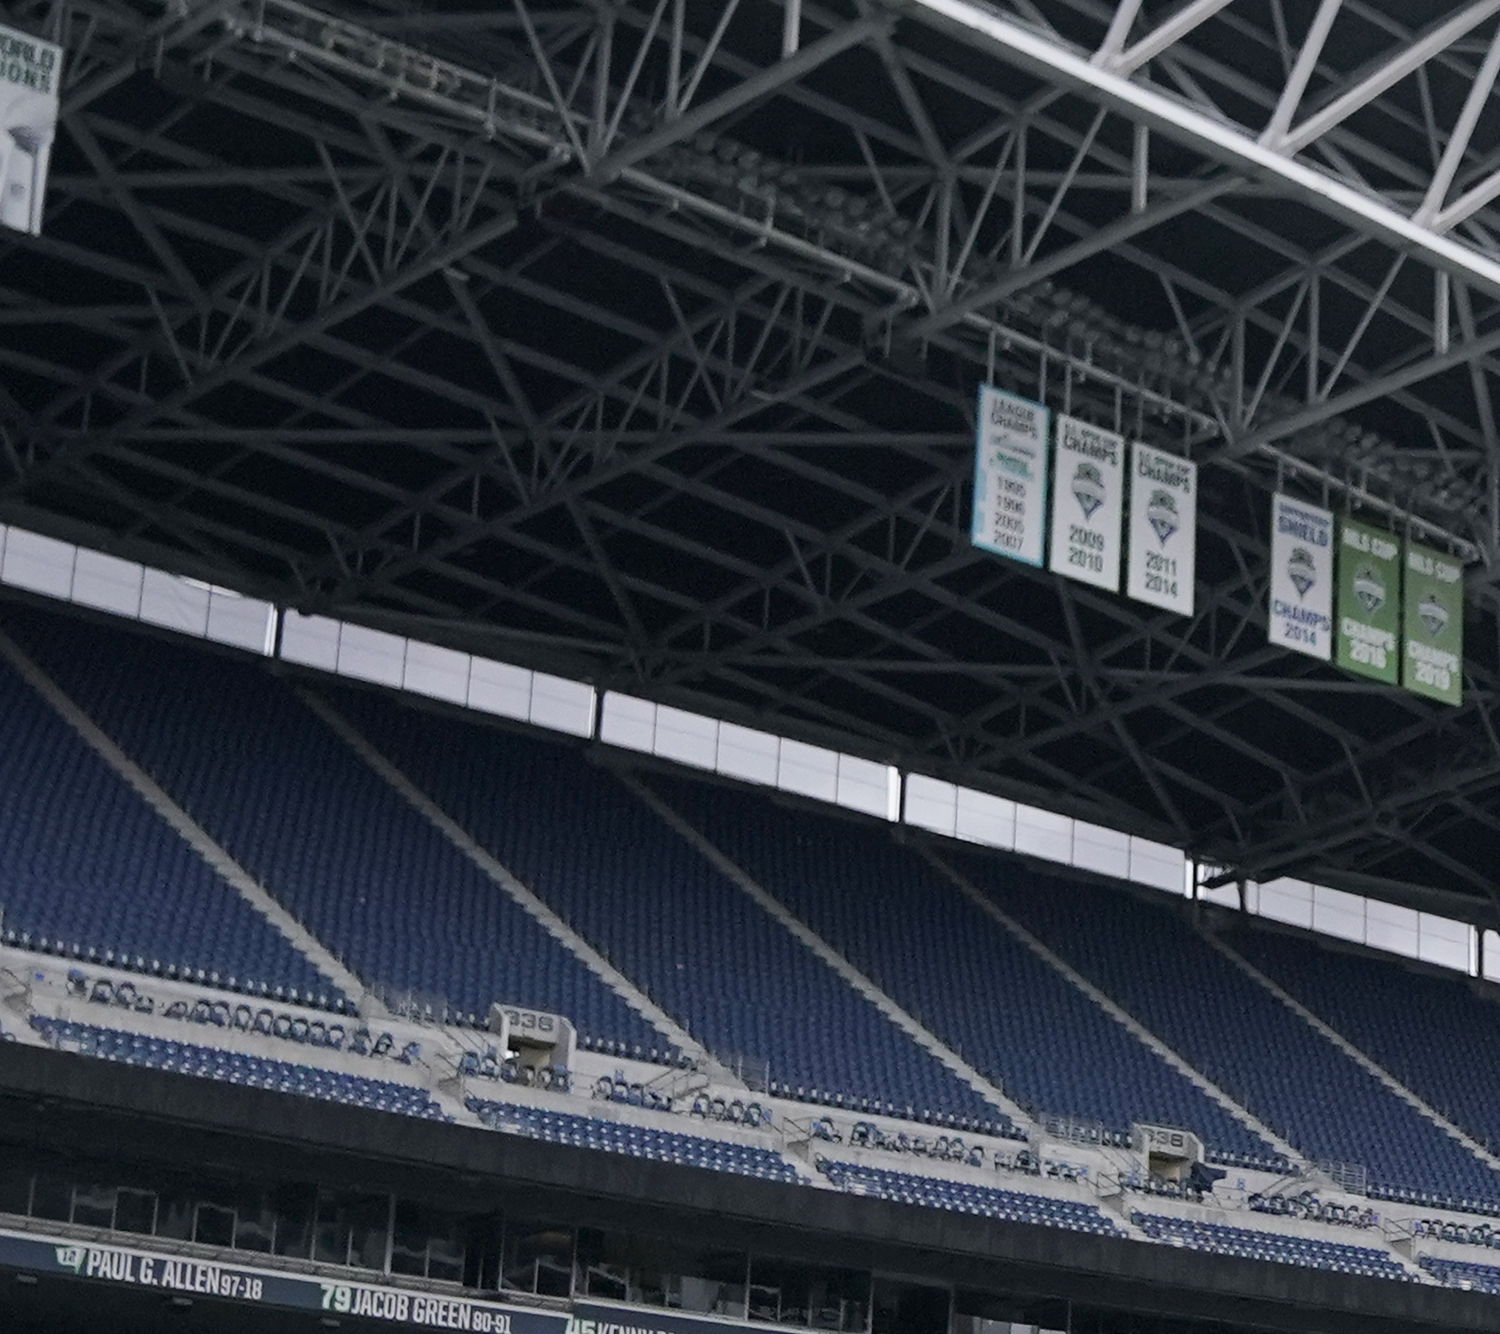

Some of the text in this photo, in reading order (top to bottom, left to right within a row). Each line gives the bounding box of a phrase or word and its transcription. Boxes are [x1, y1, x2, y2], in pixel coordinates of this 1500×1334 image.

[1063, 437, 1119, 468] CHAMPS
[1138, 464, 1191, 495] CHAMPS
[1069, 524, 1106, 553] 2009
[1278, 516, 1329, 547] SHIELD
[1342, 527, 1398, 562] MLS CUP
[1145, 550, 1177, 577] 2011
[1145, 571, 1179, 599] 2014
[1273, 598, 1331, 633] CHAMPS
[1284, 621, 1317, 647] 2014
[1341, 616, 1396, 652] CHAMPS
[1407, 638, 1460, 674] CHAMPS
[86, 1249, 138, 1282] PAUL
[138, 1257, 159, 1287] G.
[161, 1259, 221, 1296] ALLEN
[220, 1272, 263, 1301] 97-18
[320, 1283, 352, 1314] 79
[351, 1287, 409, 1324] JACOB
[412, 1299, 472, 1331] GREEN
